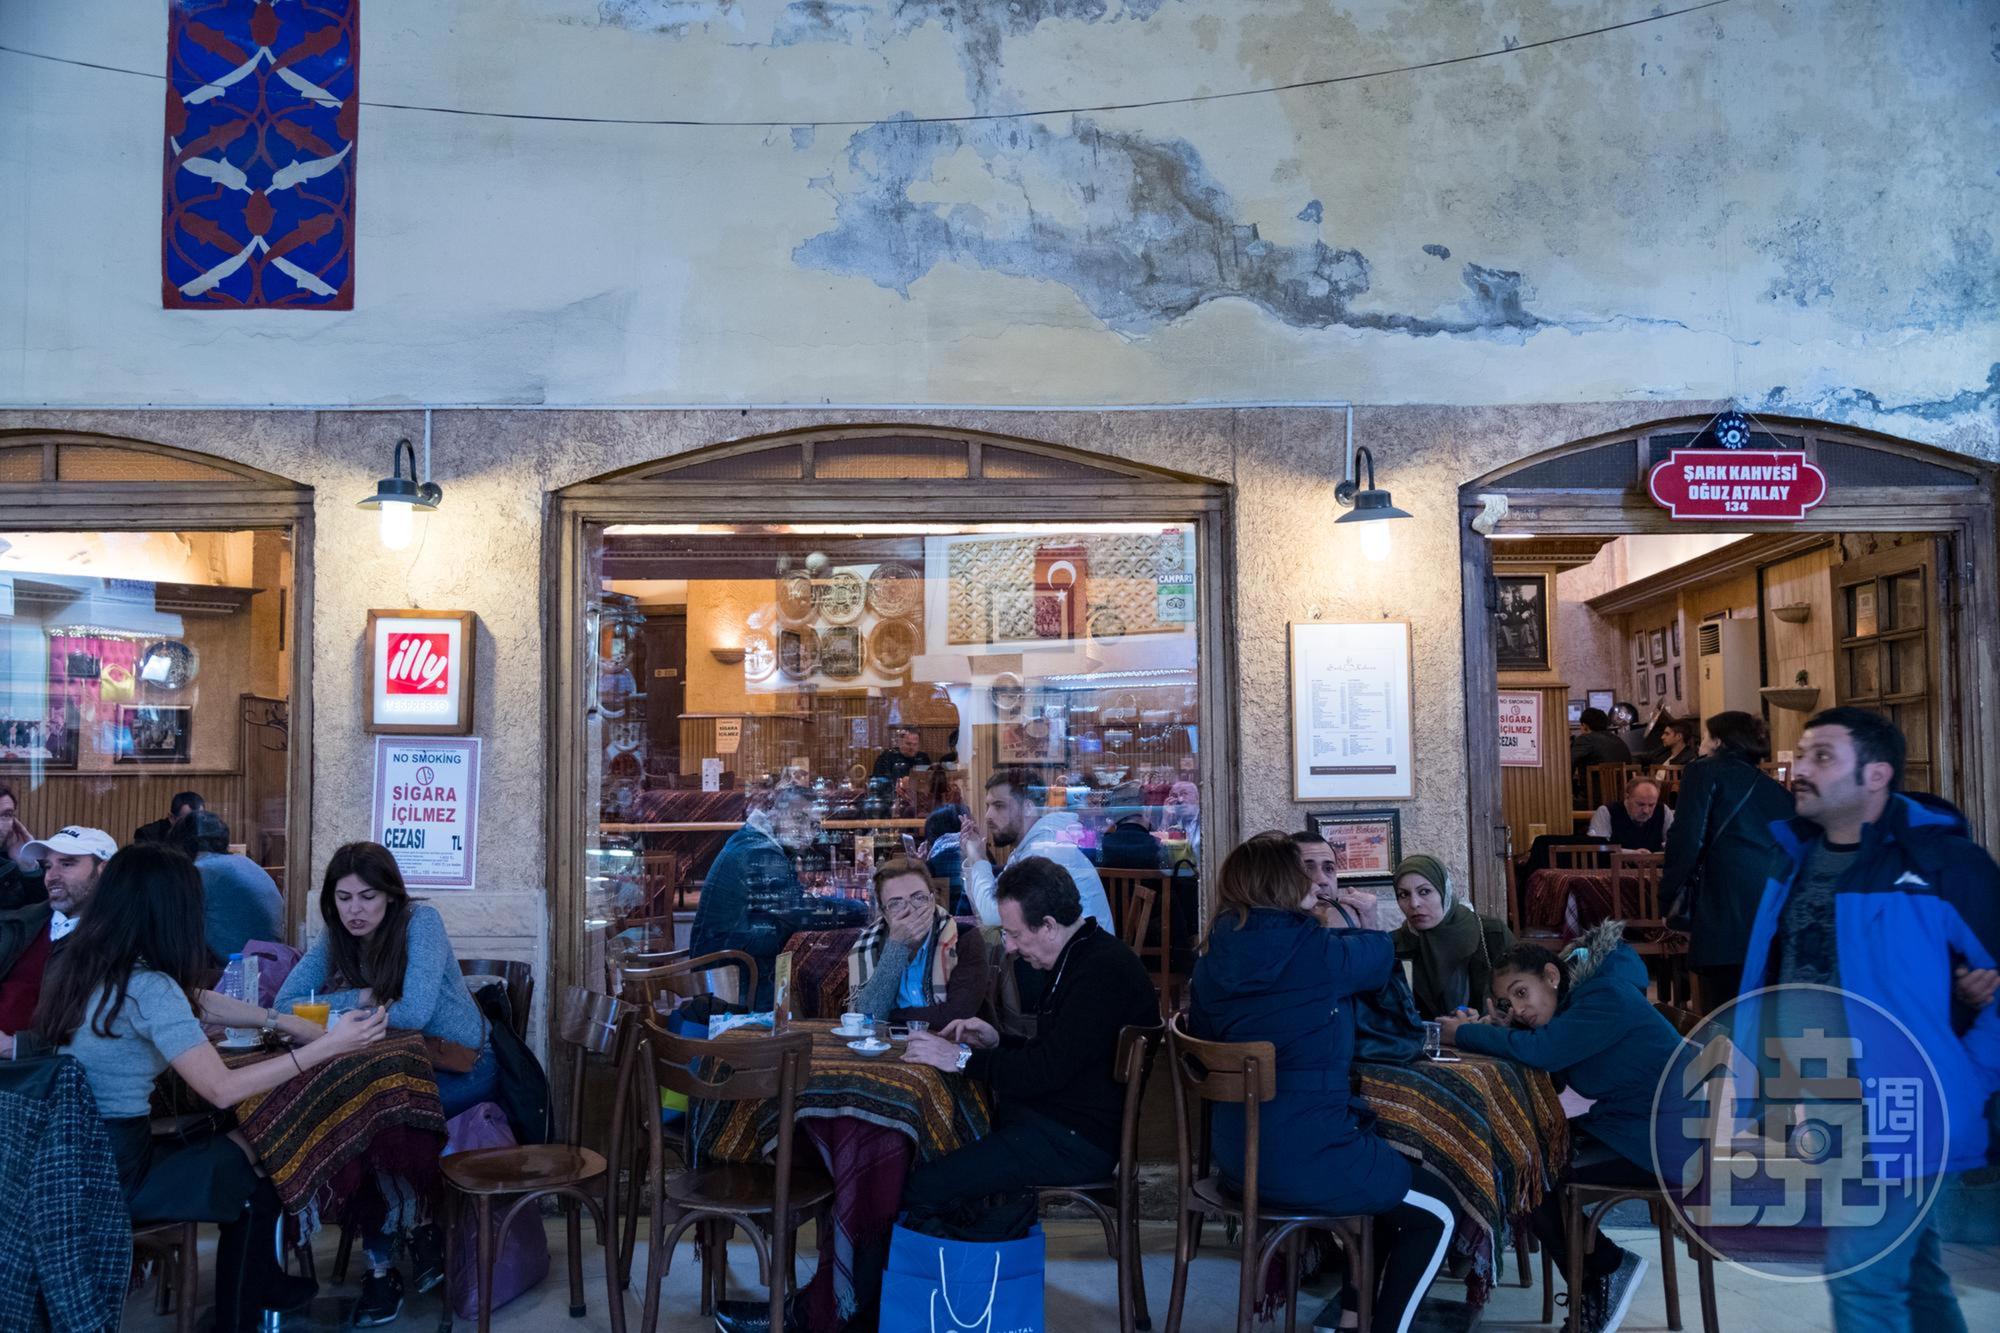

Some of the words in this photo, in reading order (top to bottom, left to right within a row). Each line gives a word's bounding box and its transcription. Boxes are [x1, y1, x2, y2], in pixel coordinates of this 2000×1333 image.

[1683, 465, 1727, 482] ŞARK
[1729, 463, 1797, 481] KAHVESİ
[1688, 483, 1730, 500] OĞUZ
[1731, 485, 1790, 500] ATALAY
[1724, 501, 1748, 512] 134
[1159, 574, 1192, 583] CAMPARI
[1499, 714, 1532, 723] SİGARA
[1500, 725, 1532, 735] İÇİLMEZ
[393, 753, 409, 763] NO
[392, 782, 457, 802] SİGARA
[391, 803, 456, 825] İÇİLMEZ
[384, 828, 425, 849] CEZASI
[451, 835, 462, 851] TL
